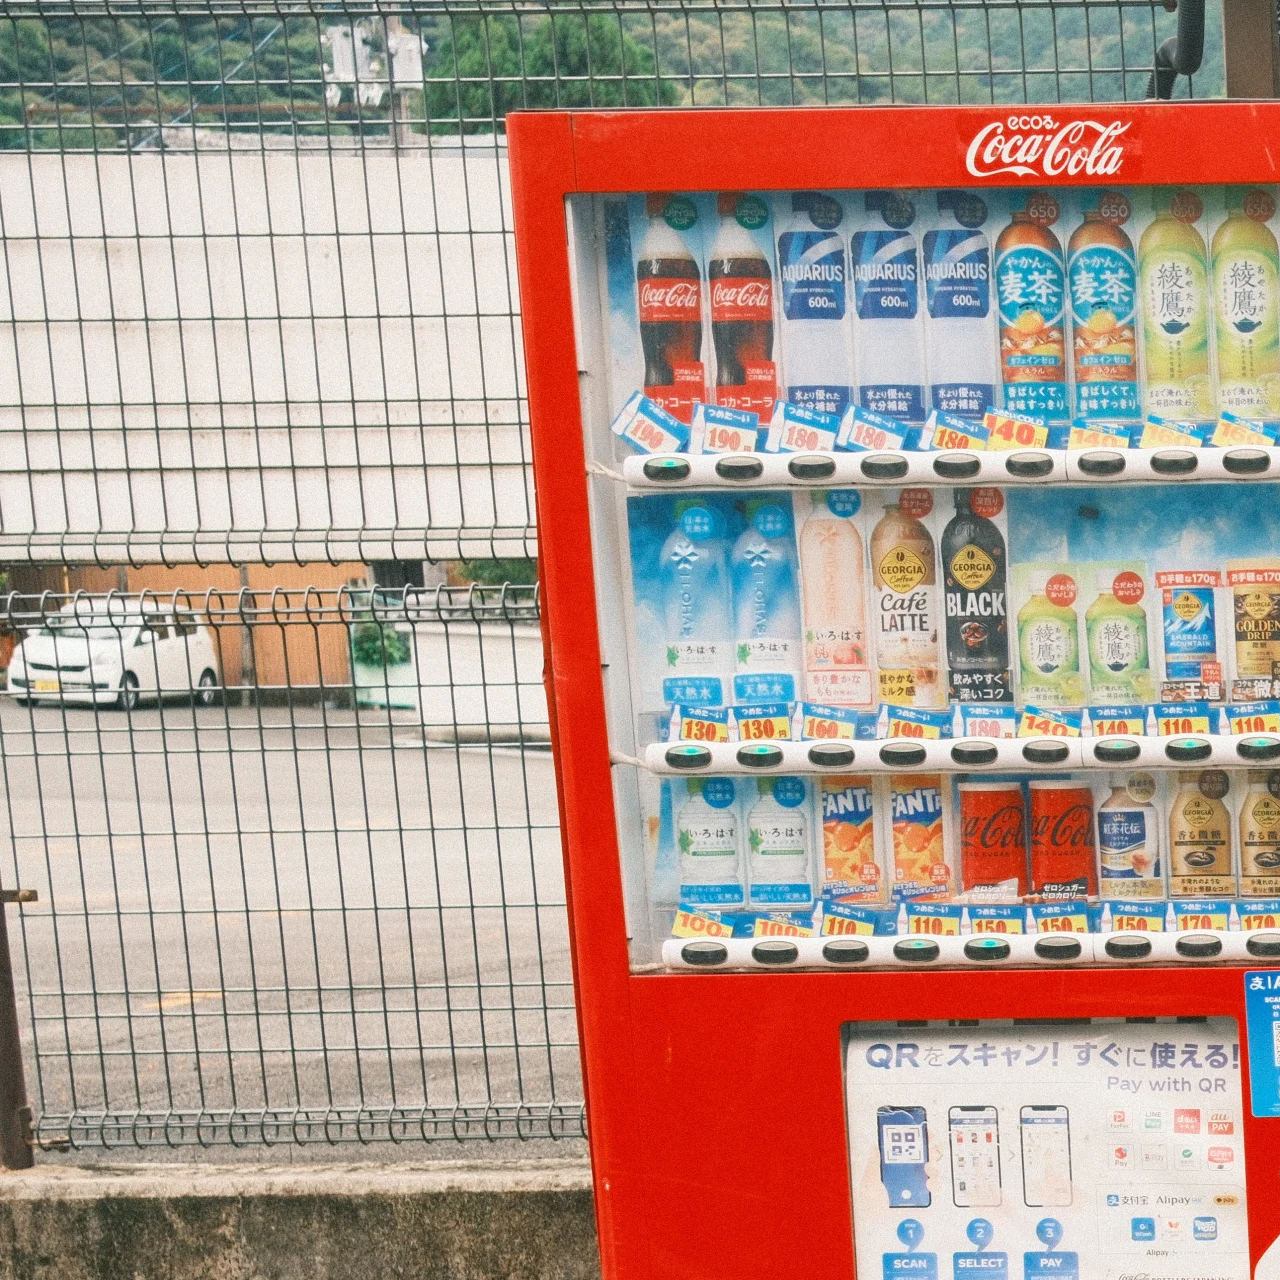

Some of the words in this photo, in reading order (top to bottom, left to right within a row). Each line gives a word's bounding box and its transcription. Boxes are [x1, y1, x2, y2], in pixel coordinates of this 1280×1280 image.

[966, 121, 1132, 177] Coca-Cola
[1029, 204, 1056, 218] 650
[1101, 204, 1128, 218] 650
[783, 265, 843, 282] AQUARIUS
[855, 264, 916, 281] AQUARIUS
[927, 263, 988, 281] AQUARIUS
[1000, 271, 1062, 304] 麦茶
[1072, 270, 1134, 304] 麦茶
[1157, 262, 1187, 317] 綾鷹
[1184, 266, 1195, 314] あやたか
[1230, 261, 1257, 317] 綾鷹
[1257, 265, 1267, 314] あやたか
[642, 283, 699, 308] Coca-Cola
[713, 282, 770, 308] Coca-Cola
[953, 294, 980, 307] 600ml
[809, 296, 837, 309] 600ml
[881, 295, 908, 308] 600ml
[795, 390, 840, 401] 水より優れた
[867, 388, 912, 399] 水より優れた
[938, 387, 983, 399] 水より優れた
[870, 400, 909, 412] 水分補給
[941, 399, 979, 411] 水分補給
[630, 418, 664, 449] 190
[881, 565, 923, 575] GEORGIA
[953, 563, 992, 572] GEORGIA
[1160, 573, 1216, 584] お手軽な170g
[880, 591, 928, 612] Café
[947, 592, 1005, 617] BLACK
[881, 613, 929, 632] LATTE
[1247, 630, 1272, 640] DRIP
[880, 674, 915, 684] 軽やかな
[953, 673, 1003, 685] 飲みやすく
[673, 687, 712, 699] 天然水
[745, 683, 784, 695] 天然水
[882, 687, 916, 697] ミルク感
[960, 688, 1004, 700] 深いコク
[1184, 682, 1220, 700] 王道
[1183, 808, 1212, 816] GEORGIA
[1103, 823, 1141, 834] 紅茶花伝
[1178, 830, 1221, 840] 香る微糖
[1043, 884, 1086, 892] ゼロシュガー
[1041, 892, 1088, 900] ゼロカロリー
[865, 1042, 1060, 1069] QRをスキャン!
[1073, 1042, 1239, 1069] すぐに使える!
[1107, 1076, 1142, 1093] Pay
[1150, 1076, 1192, 1092] with
[1198, 1077, 1226, 1092] QR
[1210, 1112, 1228, 1121] au
[1121, 1195, 1149, 1205] 支付宝
[908, 1229, 914, 1238] 1
[976, 1229, 985, 1238] 2
[1045, 1229, 1054, 1238] 3
[1146, 1249, 1169, 1257] Alipay
[894, 1259, 927, 1269] SCAN
[958, 1258, 1004, 1268] SELECT
[1040, 1258, 1063, 1268] PAY
